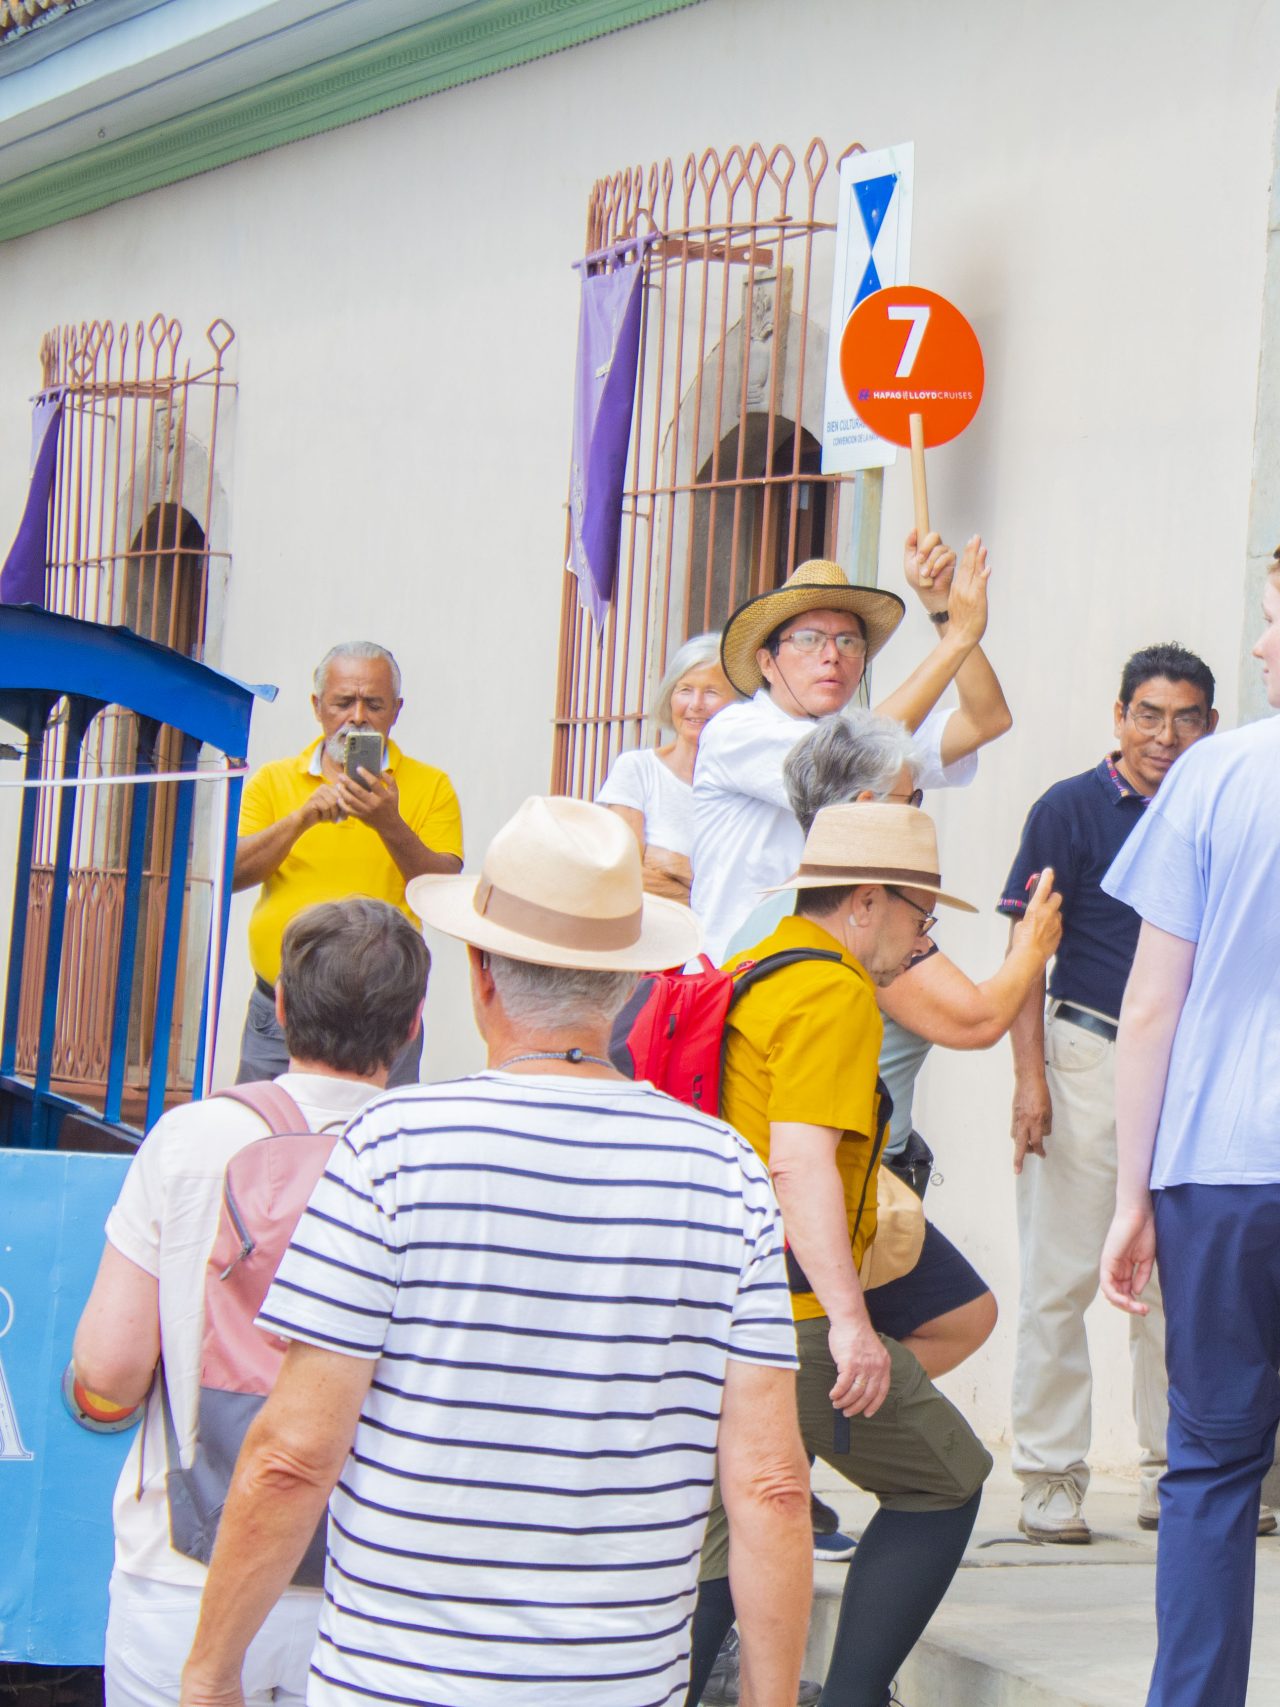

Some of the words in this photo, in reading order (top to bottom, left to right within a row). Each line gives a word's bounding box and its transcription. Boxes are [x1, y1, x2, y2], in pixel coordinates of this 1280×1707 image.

[887, 304, 931, 378] 7
[873, 391, 901, 400] HAPAG
[909, 391, 937, 400] LLOYD
[937, 391, 973, 400] CRUISES
[826, 421, 839, 433] BIEN
